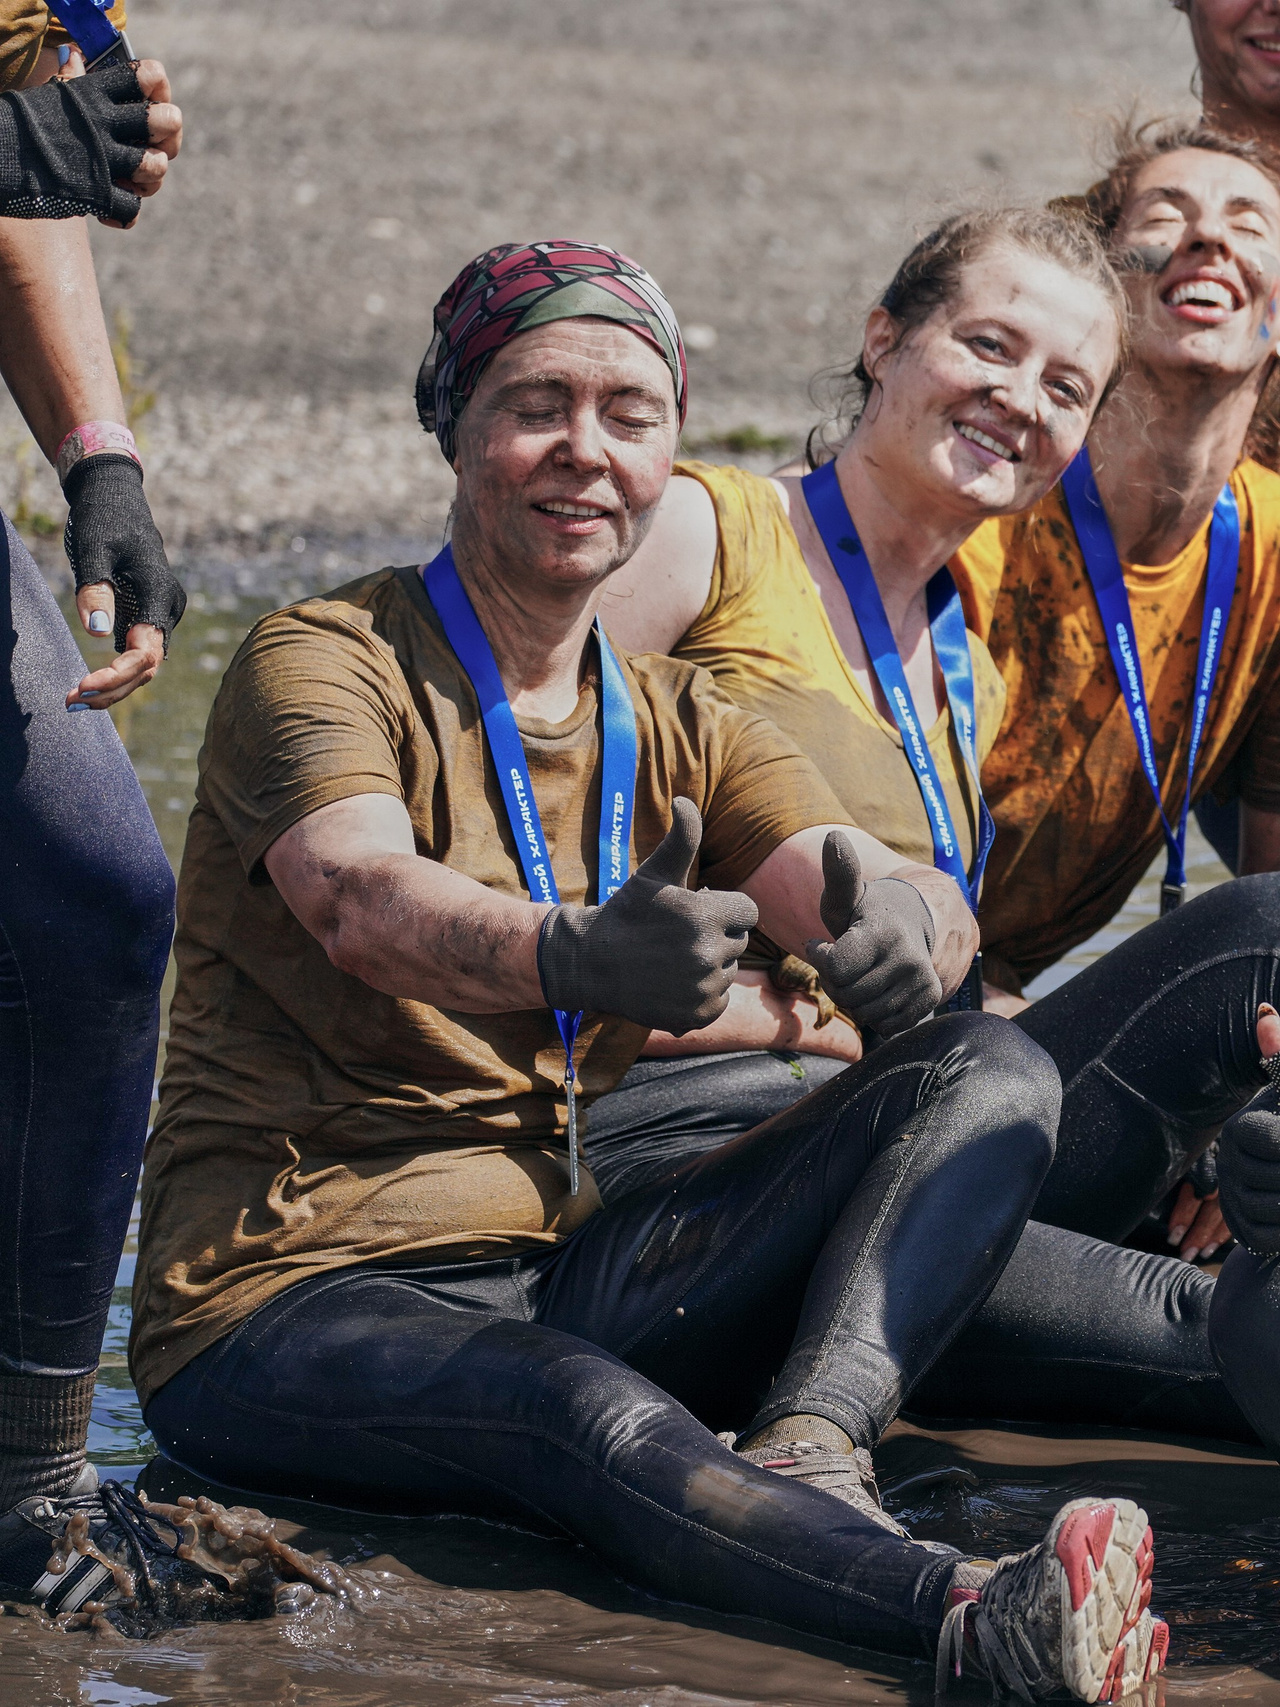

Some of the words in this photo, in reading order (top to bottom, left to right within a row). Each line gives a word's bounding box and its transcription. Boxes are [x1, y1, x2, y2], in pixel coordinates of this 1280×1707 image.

[893, 686, 928, 769] ХАРАКТЕР
[510, 768, 542, 859] ХАРАКТЕР
[611, 791, 625, 881] ХАРАКТЕР
[920, 774, 954, 858] СТАЛЬНОЙ
